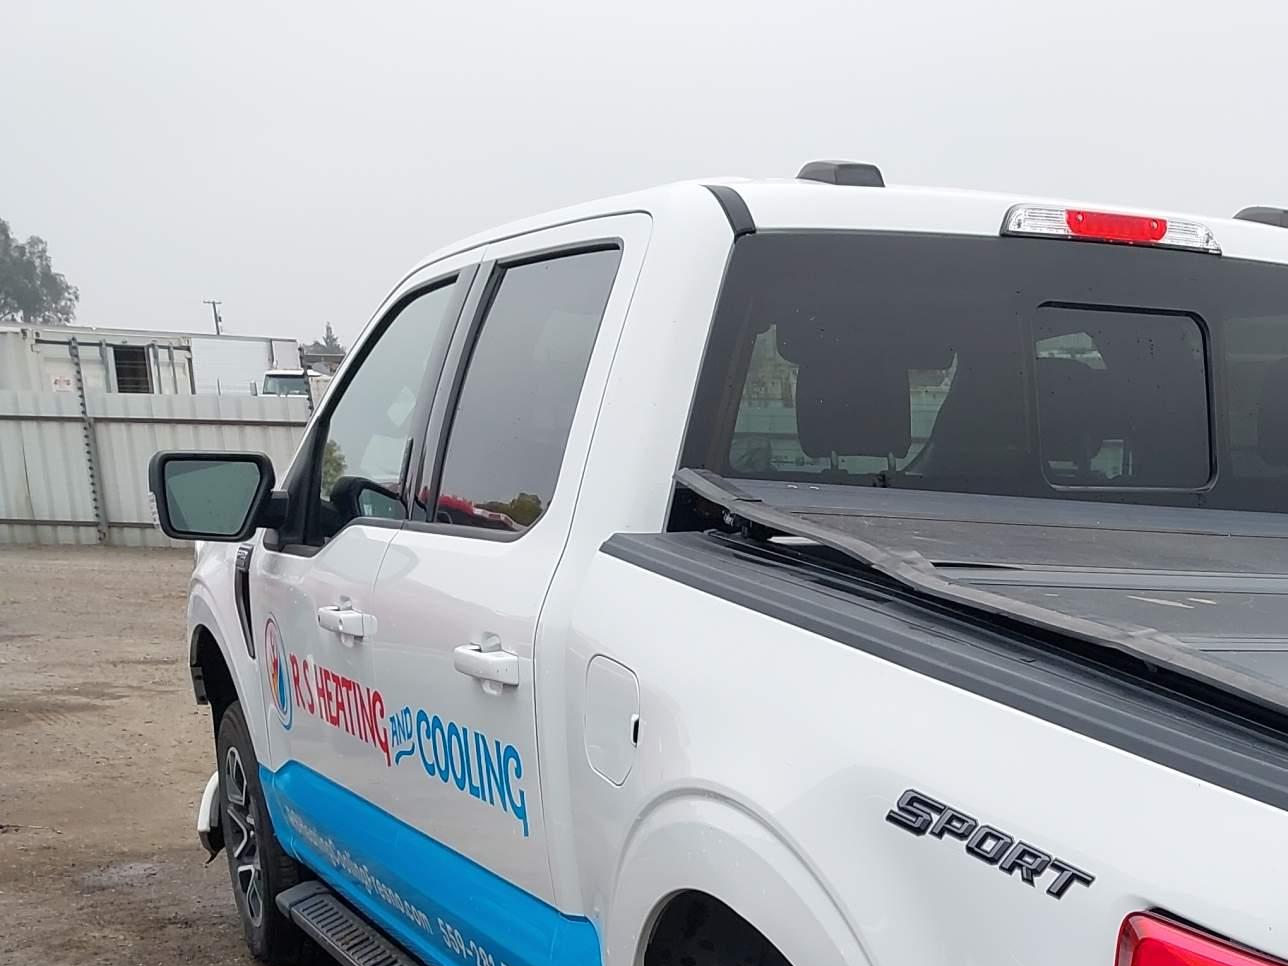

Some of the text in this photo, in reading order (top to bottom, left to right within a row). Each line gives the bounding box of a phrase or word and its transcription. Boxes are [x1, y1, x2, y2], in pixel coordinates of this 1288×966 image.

[289, 653, 392, 767] R S HEATING
[391, 707, 529, 837] AND COOLING
[885, 788, 1096, 900] SPORT
